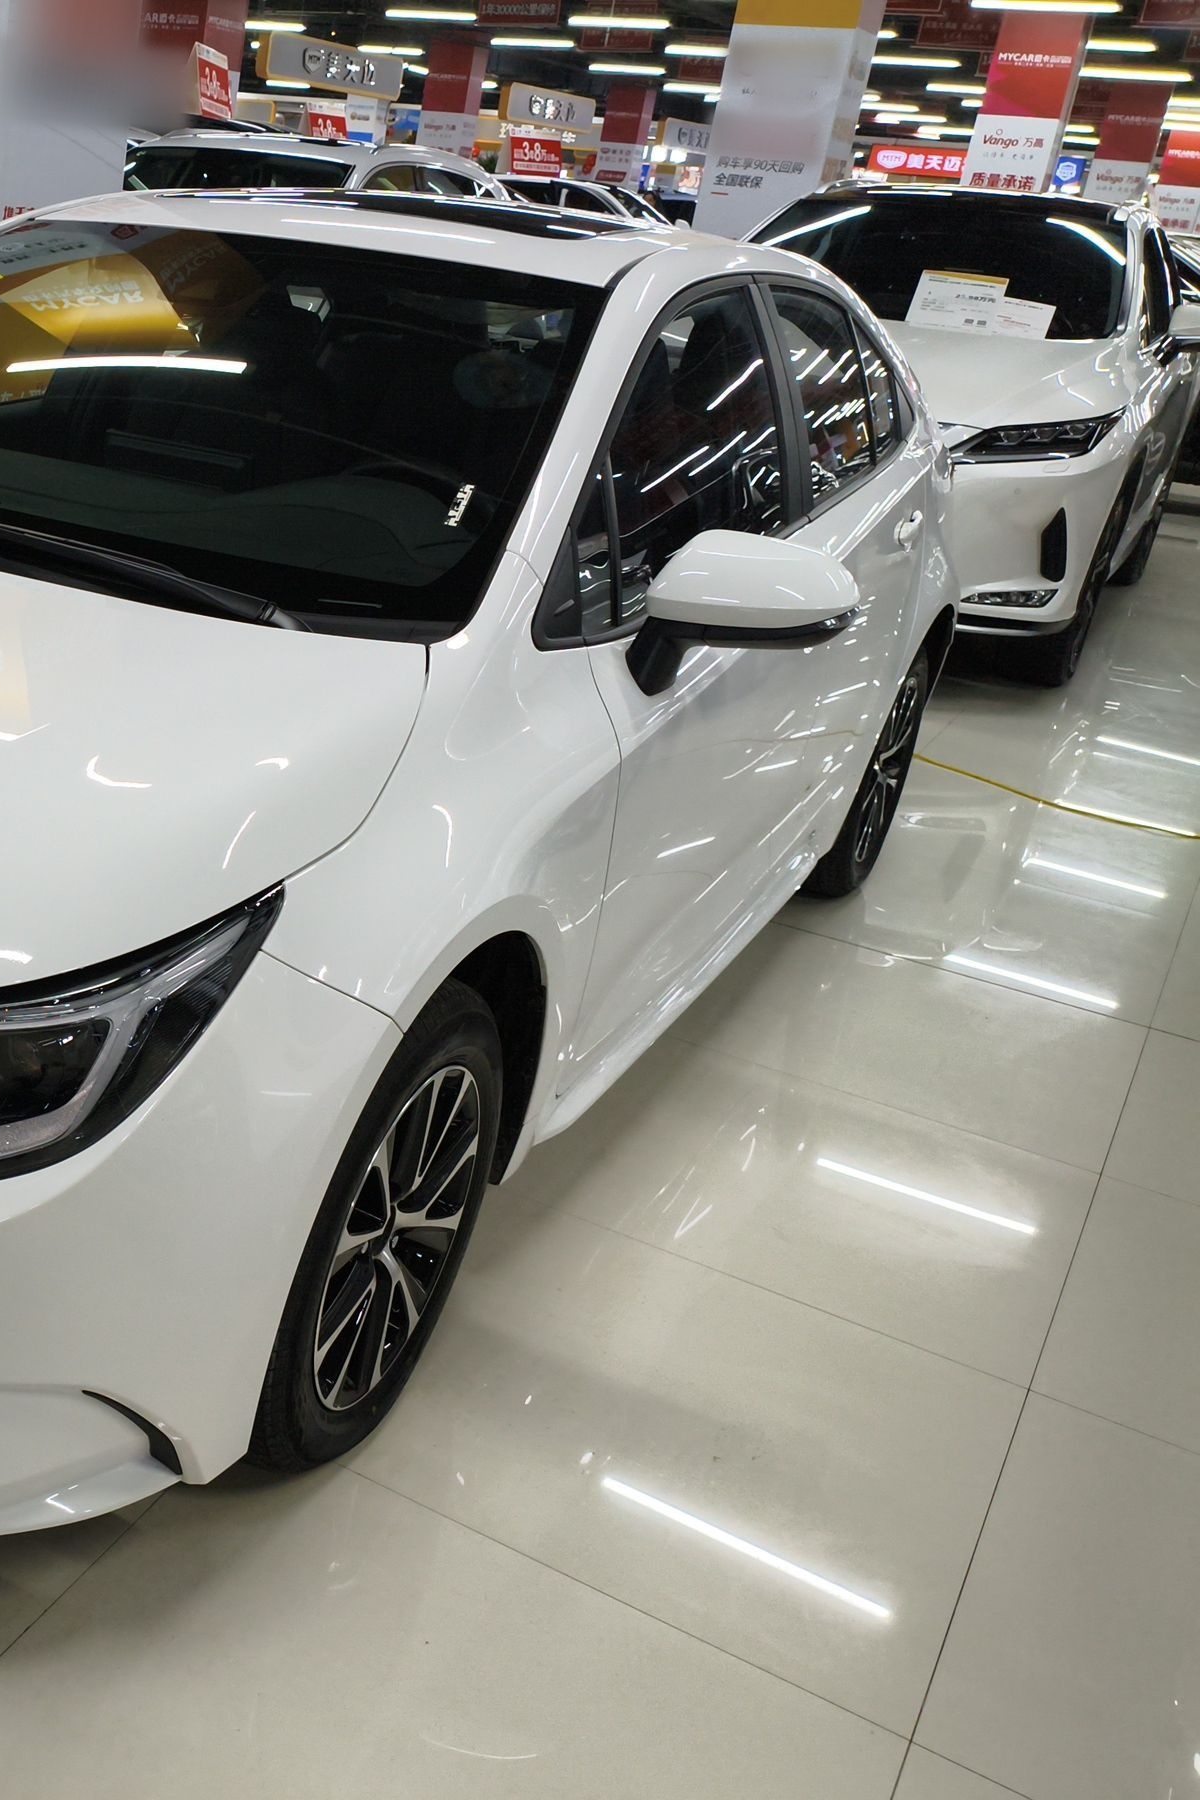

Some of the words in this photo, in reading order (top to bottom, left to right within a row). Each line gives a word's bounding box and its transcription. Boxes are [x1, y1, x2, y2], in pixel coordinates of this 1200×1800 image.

[982, 134, 1020, 149] Vango
[717, 156, 805, 174] 购车享90天回购
[713, 172, 764, 188] 全国联保
[969, 172, 1035, 191] 质量承诺
